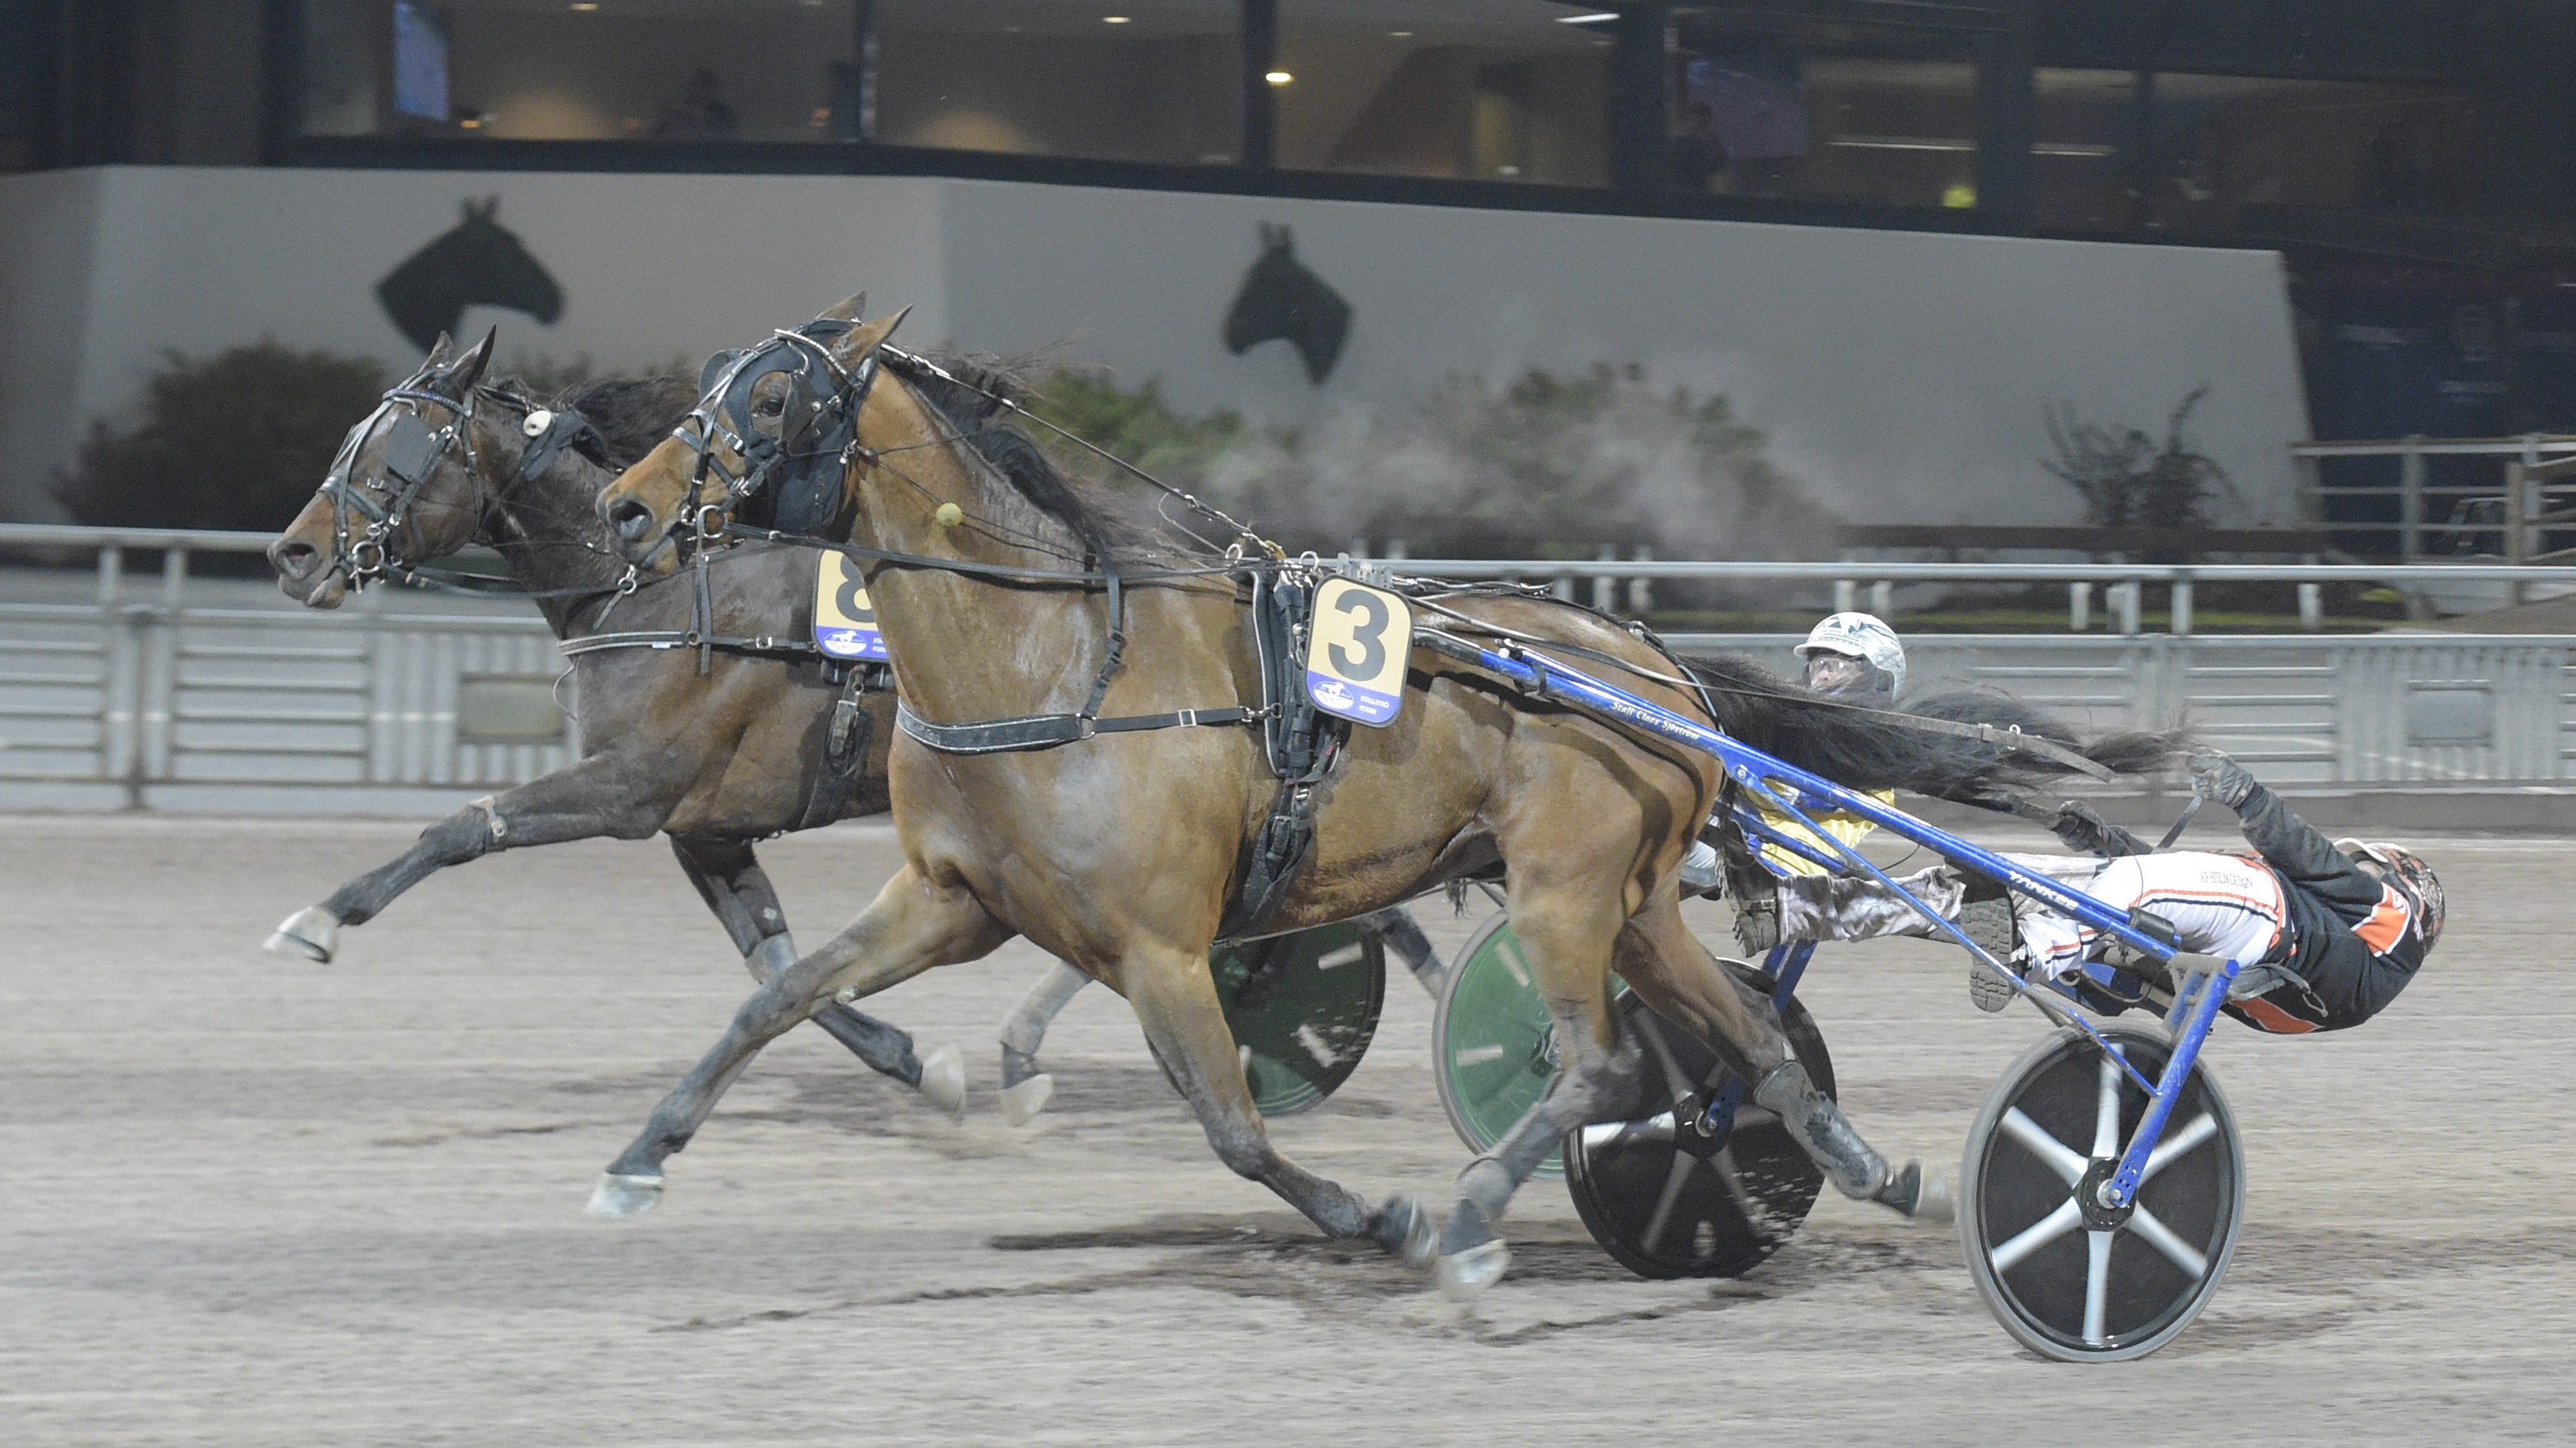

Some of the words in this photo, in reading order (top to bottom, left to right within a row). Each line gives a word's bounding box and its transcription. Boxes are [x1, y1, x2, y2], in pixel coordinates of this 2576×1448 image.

[835, 553, 877, 624] 8
[1328, 588, 1390, 682] 3
[1611, 701, 1635, 716] Stall
[1636, 710, 1660, 726] Claes
